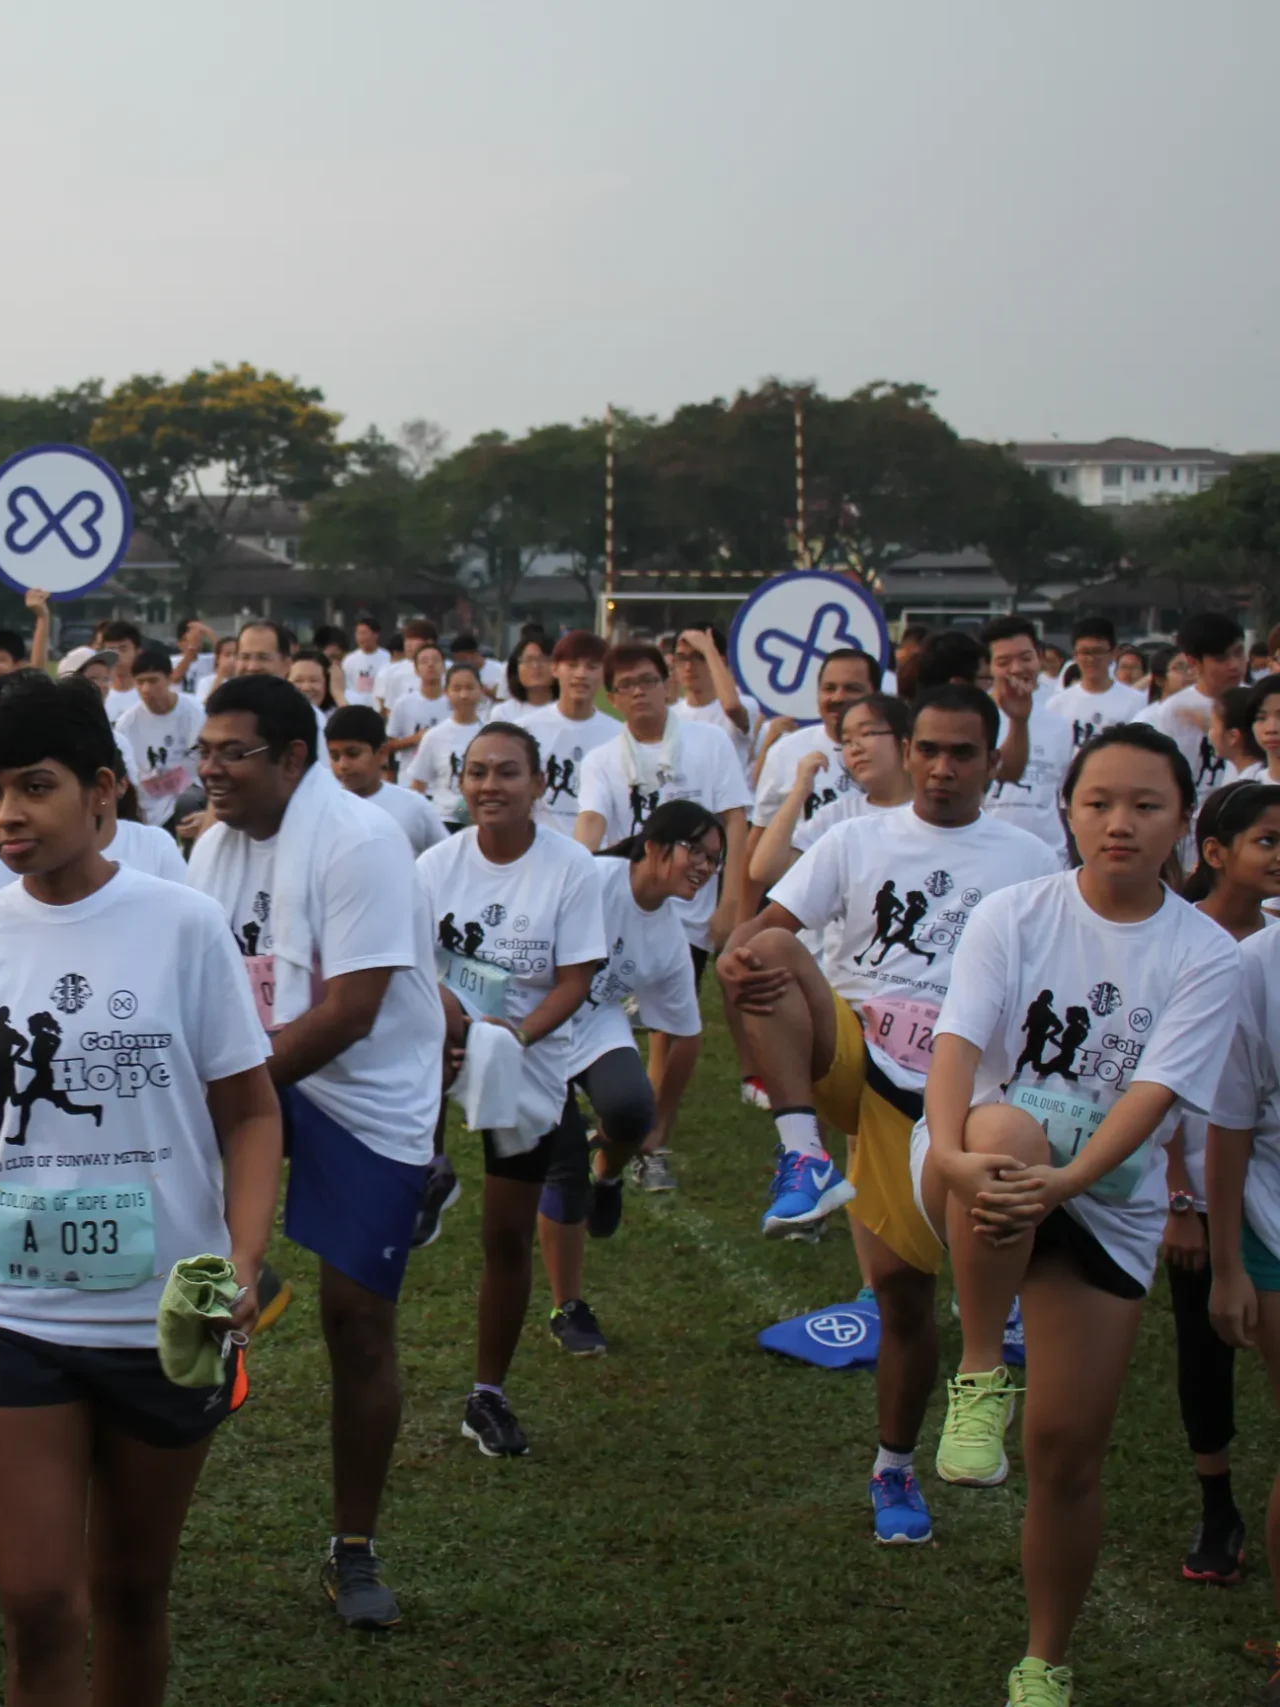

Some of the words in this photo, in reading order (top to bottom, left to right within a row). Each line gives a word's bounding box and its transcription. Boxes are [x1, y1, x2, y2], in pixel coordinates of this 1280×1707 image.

[495, 938, 550, 950] Colours
[512, 949, 527, 960] of
[460, 967, 484, 996] 031
[80, 1031, 172, 1051] Colours
[115, 1049, 141, 1066] of
[50, 1058, 171, 1098] Hope
[1021, 1092, 1066, 1114] COLOURS
[1071, 1105, 1086, 1118] OF
[5, 1156, 35, 1171] CLUB
[37, 1155, 54, 1168] OF
[56, 1153, 111, 1168] SUNWAY
[114, 1150, 156, 1165] METRO
[53, 1197, 69, 1211] OF
[76, 1195, 107, 1210] HOPE
[116, 1192, 146, 1208] 2015
[23, 1220, 38, 1253] A
[61, 1220, 118, 1255] 033
